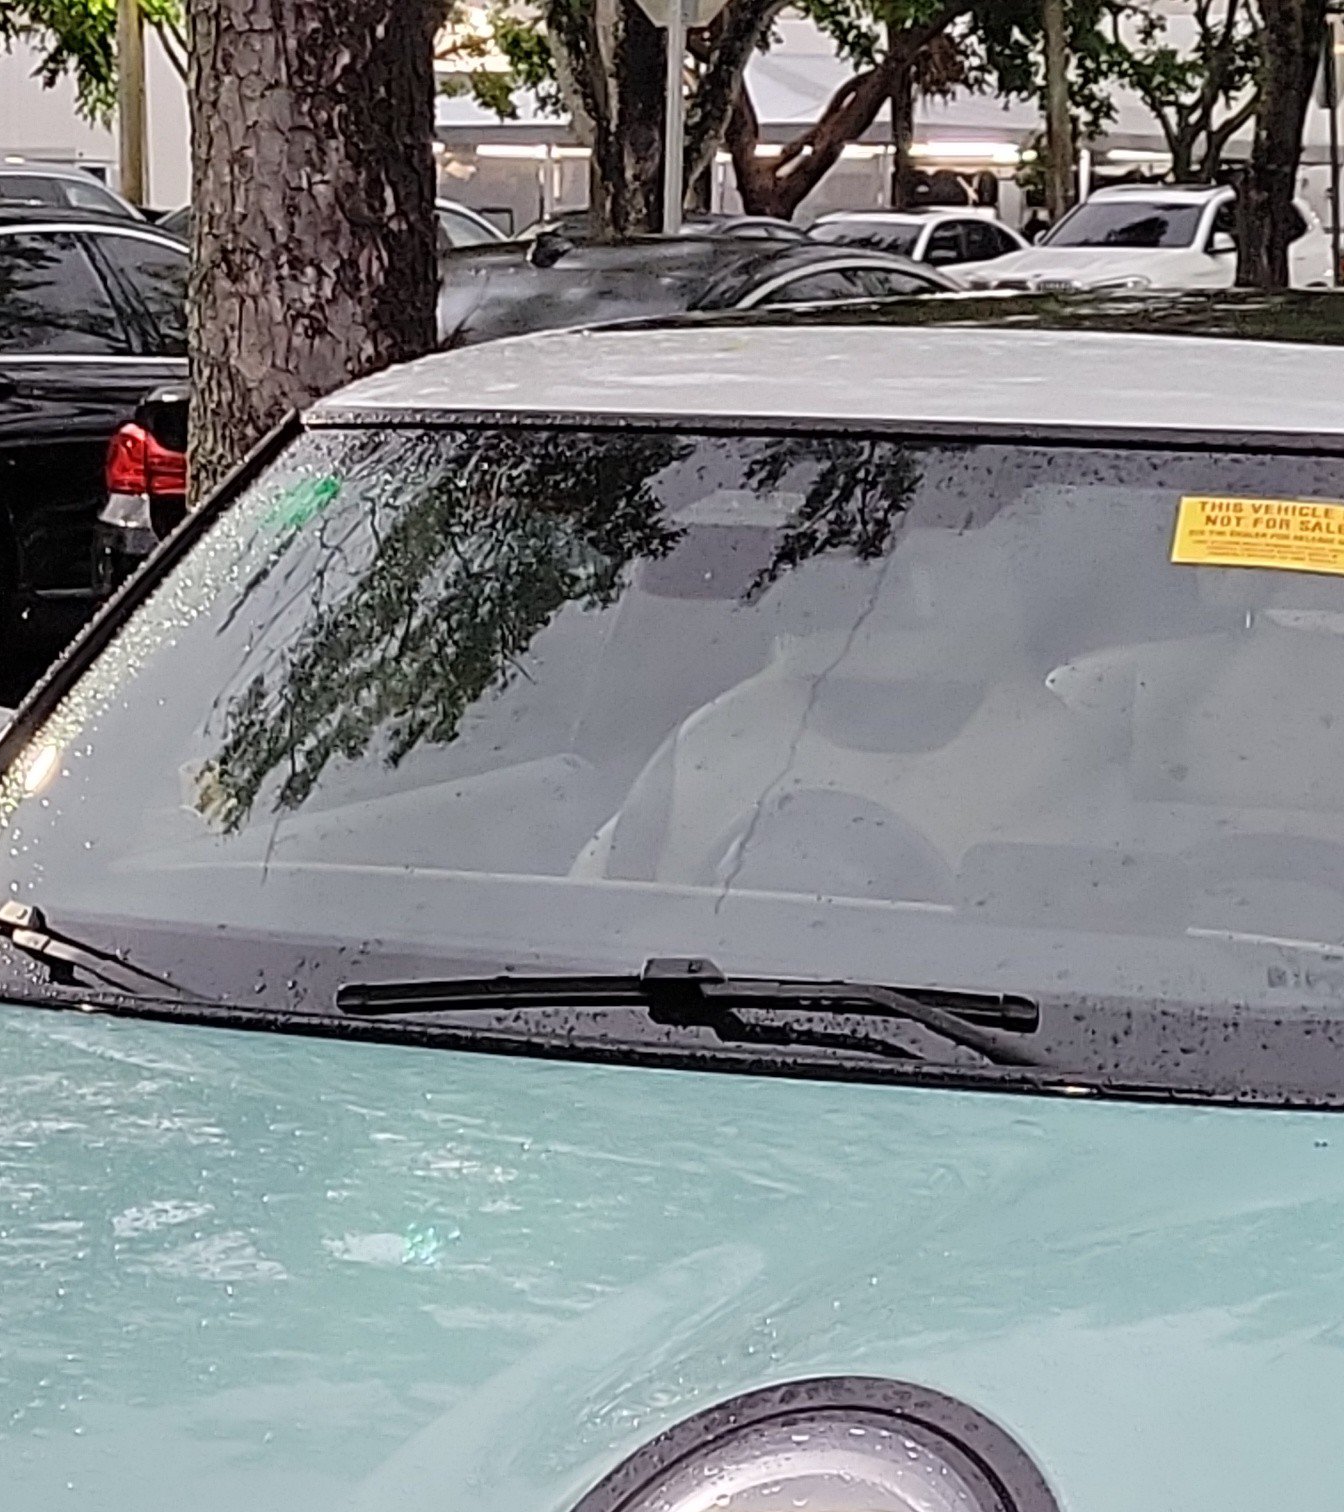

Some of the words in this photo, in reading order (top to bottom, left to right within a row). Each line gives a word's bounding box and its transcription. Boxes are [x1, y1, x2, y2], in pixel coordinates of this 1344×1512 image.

[1199, 501, 1243, 514] THIS
[1251, 503, 1336, 519] VEHICLE
[1205, 515, 1247, 527] NOT
[1253, 517, 1290, 530] FOR
